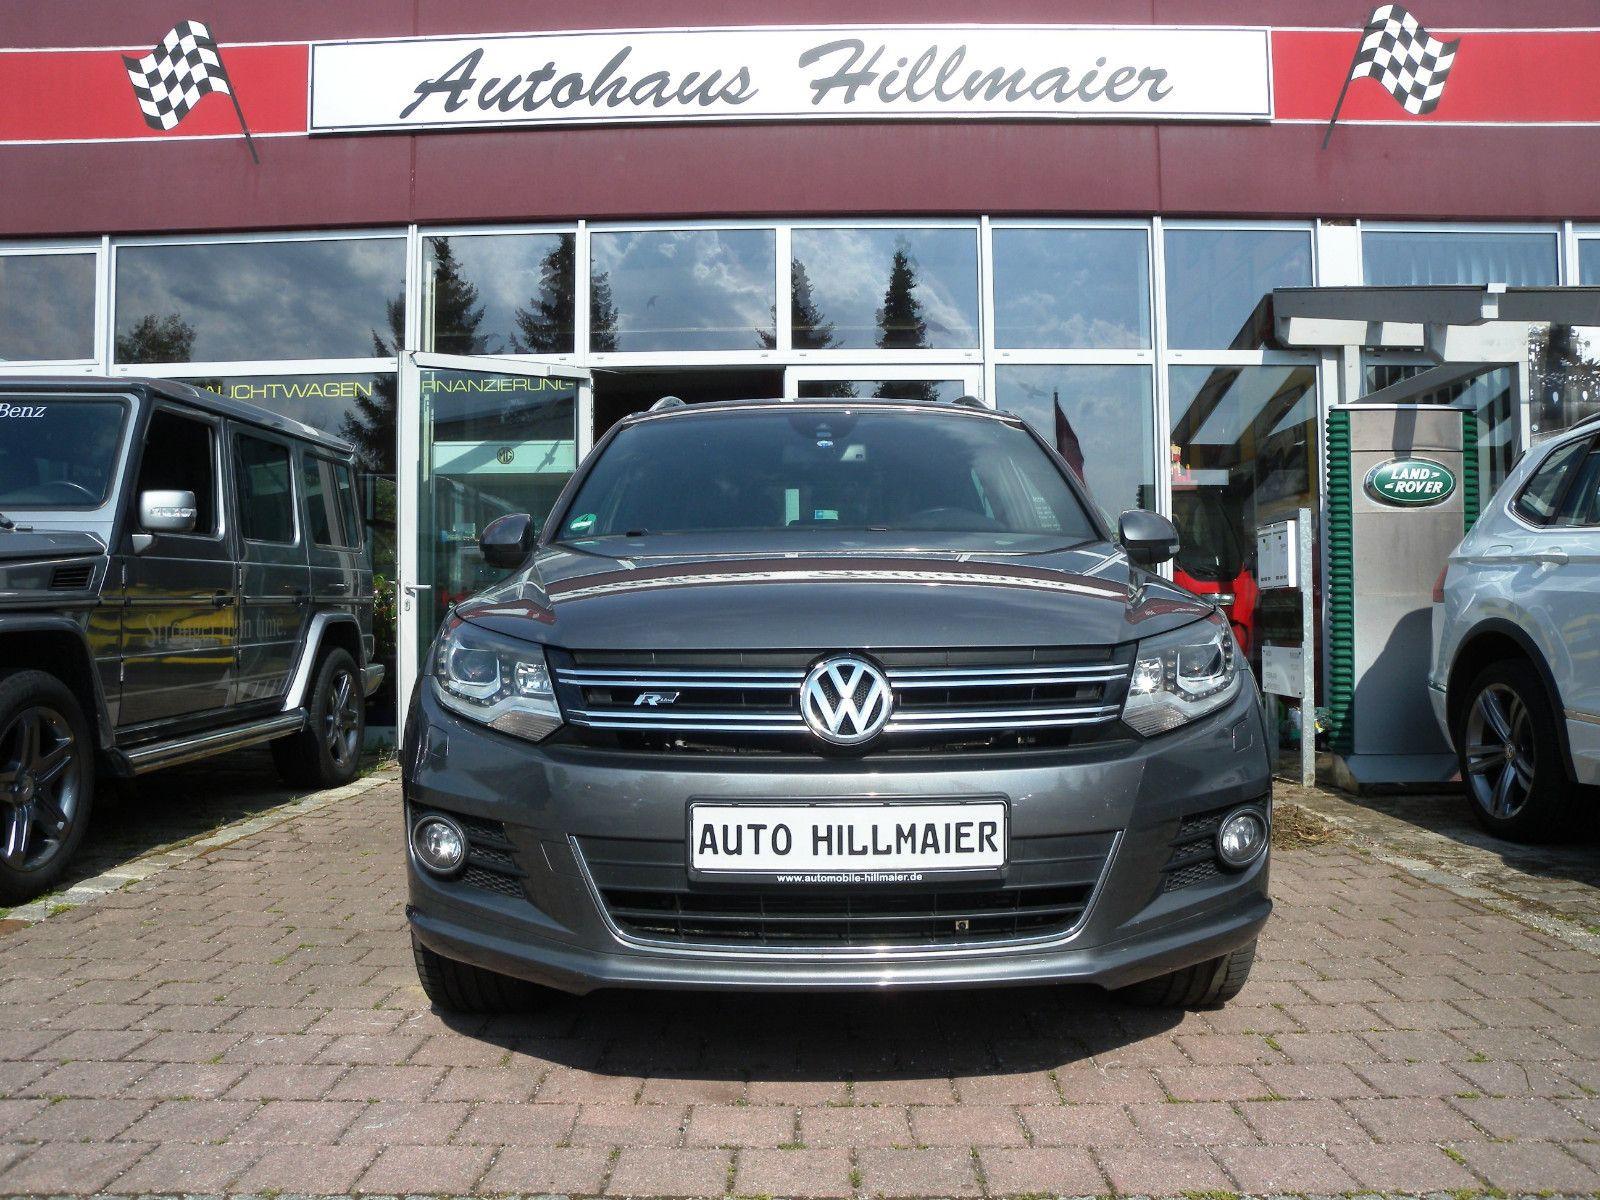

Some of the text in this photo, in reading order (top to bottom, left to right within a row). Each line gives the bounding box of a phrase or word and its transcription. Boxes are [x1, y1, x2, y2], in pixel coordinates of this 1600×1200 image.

[400, 38, 1174, 119] Autohaus Hillmaier
[0, 402, 47, 418] Benz
[1391, 468, 1429, 480] LAND
[1394, 481, 1443, 493] ROVER
[699, 821, 998, 856] AUTO HILLMAIER
[777, 872, 923, 883] www.automobile-hillmaier.de
